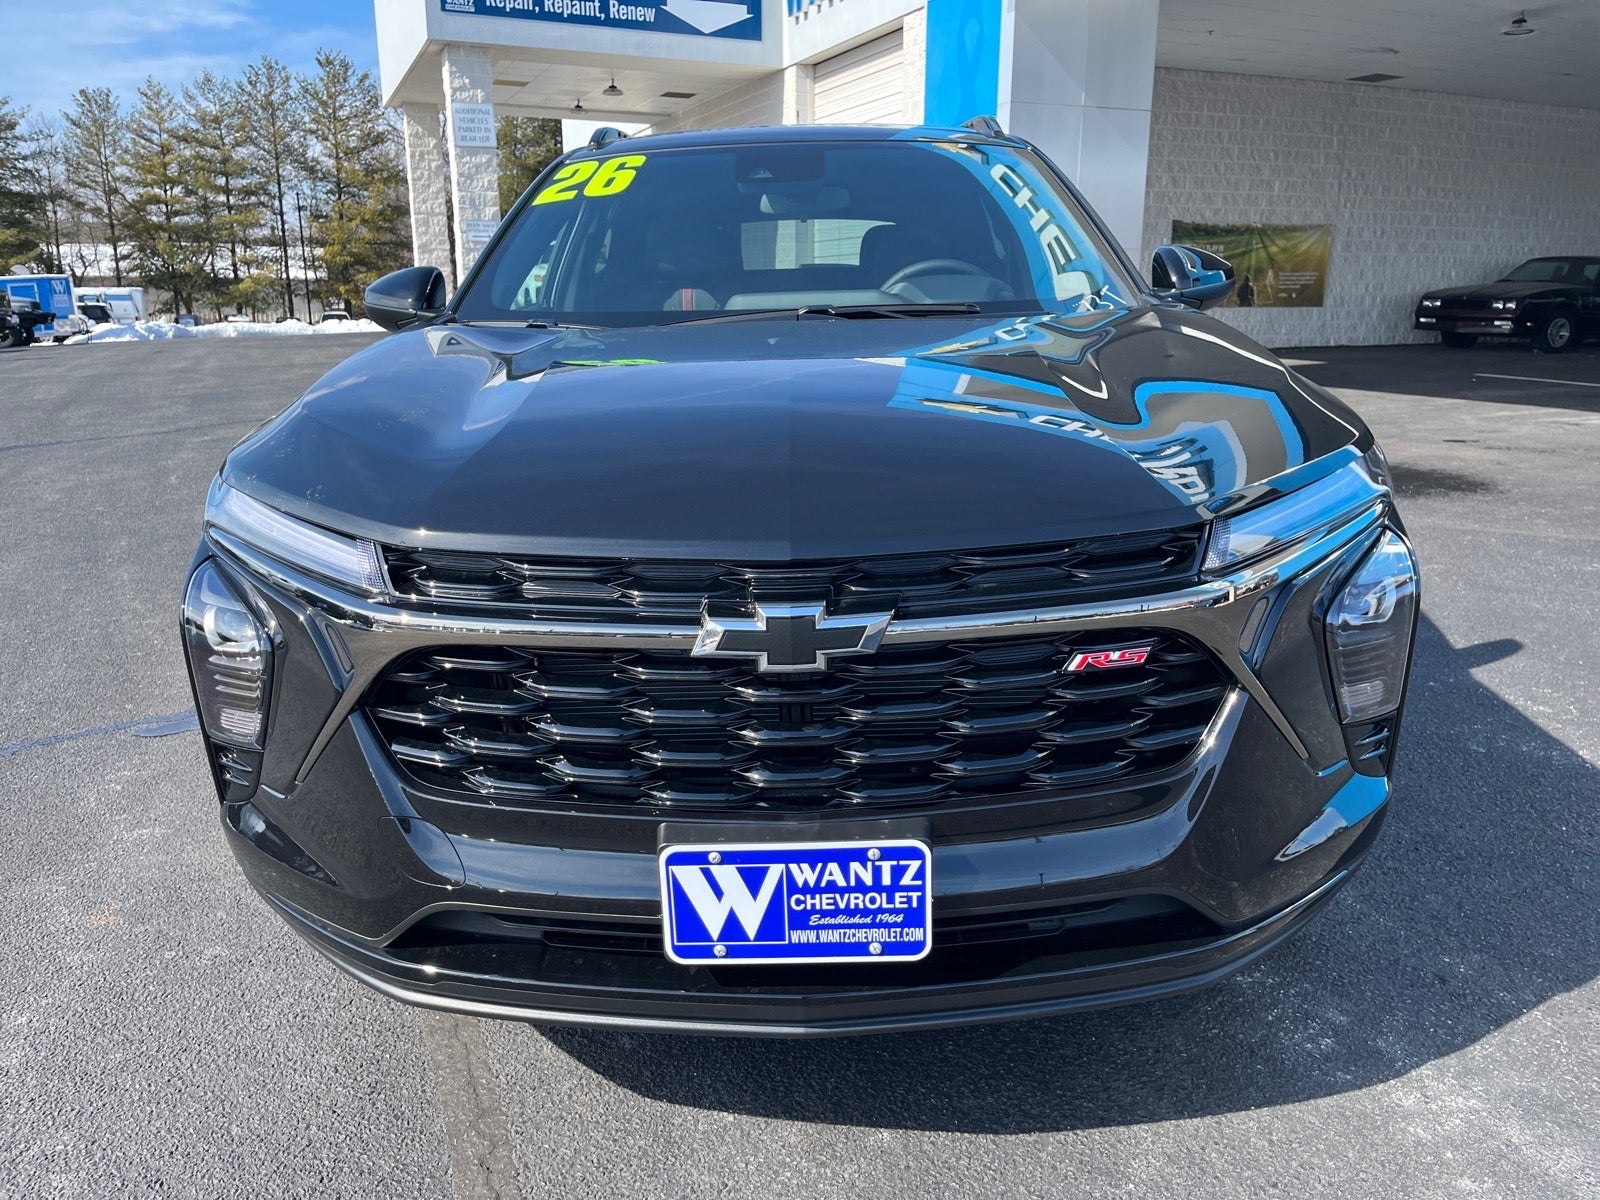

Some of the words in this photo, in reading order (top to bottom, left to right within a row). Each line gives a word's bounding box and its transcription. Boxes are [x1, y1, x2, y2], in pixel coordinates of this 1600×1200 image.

[609, 0, 656, 22] Renew
[458, 126, 482, 134] PARKED
[531, 155, 647, 206] 26
[1067, 647, 1151, 671] RS
[787, 860, 923, 888] WANTZ
[790, 892, 922, 911] CHEVROLET
[808, 914, 873, 926] Established
[876, 913, 905, 924] 1964
[790, 926, 924, 944] WWW.WANTZCHEVROLET.COM
